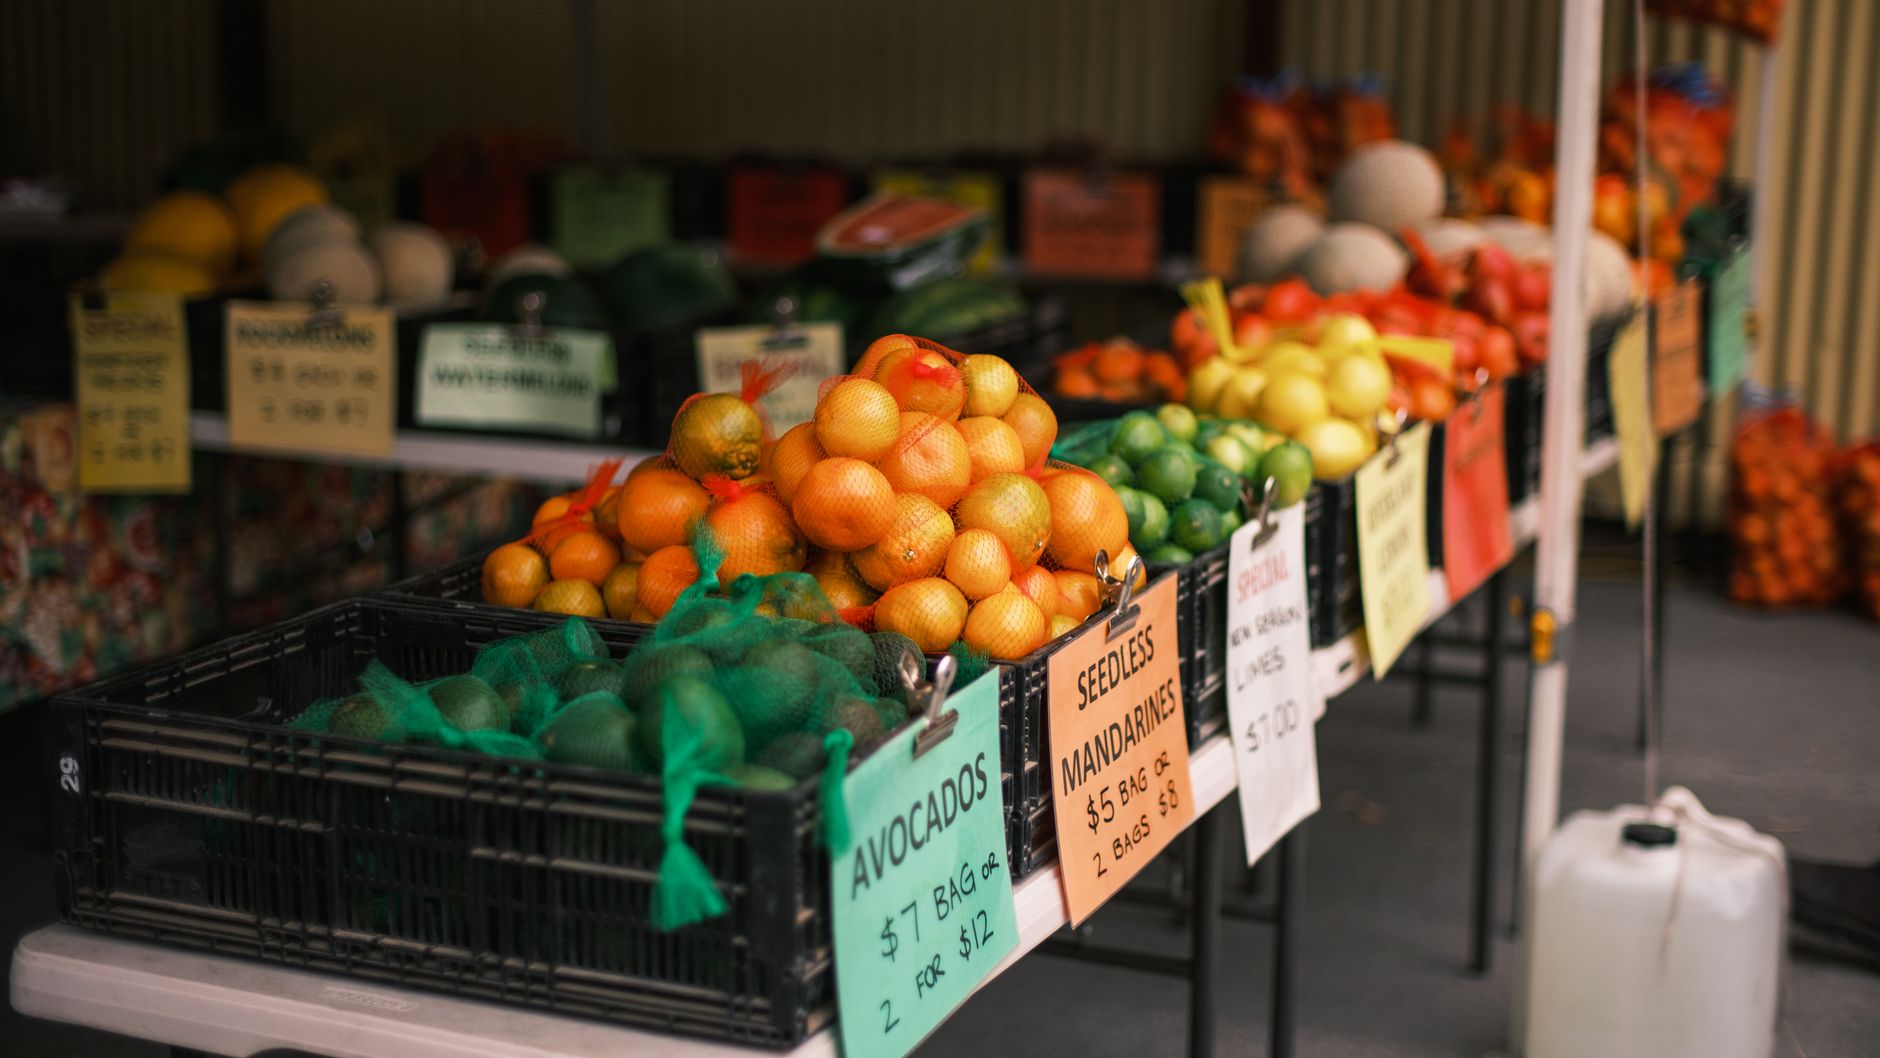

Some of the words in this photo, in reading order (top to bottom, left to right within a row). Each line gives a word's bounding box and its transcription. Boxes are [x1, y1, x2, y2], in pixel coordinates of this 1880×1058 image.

[1236, 552, 1290, 605] SPECIAL
[1077, 624, 1155, 711] SEEDLESS
[1234, 648, 1286, 694] LIMES
[1061, 677, 1176, 797] MANDARINES
[851, 751, 988, 900] AVOCADOS
[1087, 785, 1115, 835] $5
[1118, 766, 1149, 806] BAG
[1154, 751, 1170, 777] OR
[1092, 851, 1108, 878] 2
[1112, 814, 1151, 861] BAGS
[1158, 779, 1180, 818] $8
[880, 900, 921, 963] $7
[933, 862, 977, 921] BAG
[981, 852, 1001, 881] OR
[880, 999, 901, 1035] 2
[915, 953, 946, 1000] FOR
[959, 909, 995, 962] $12
